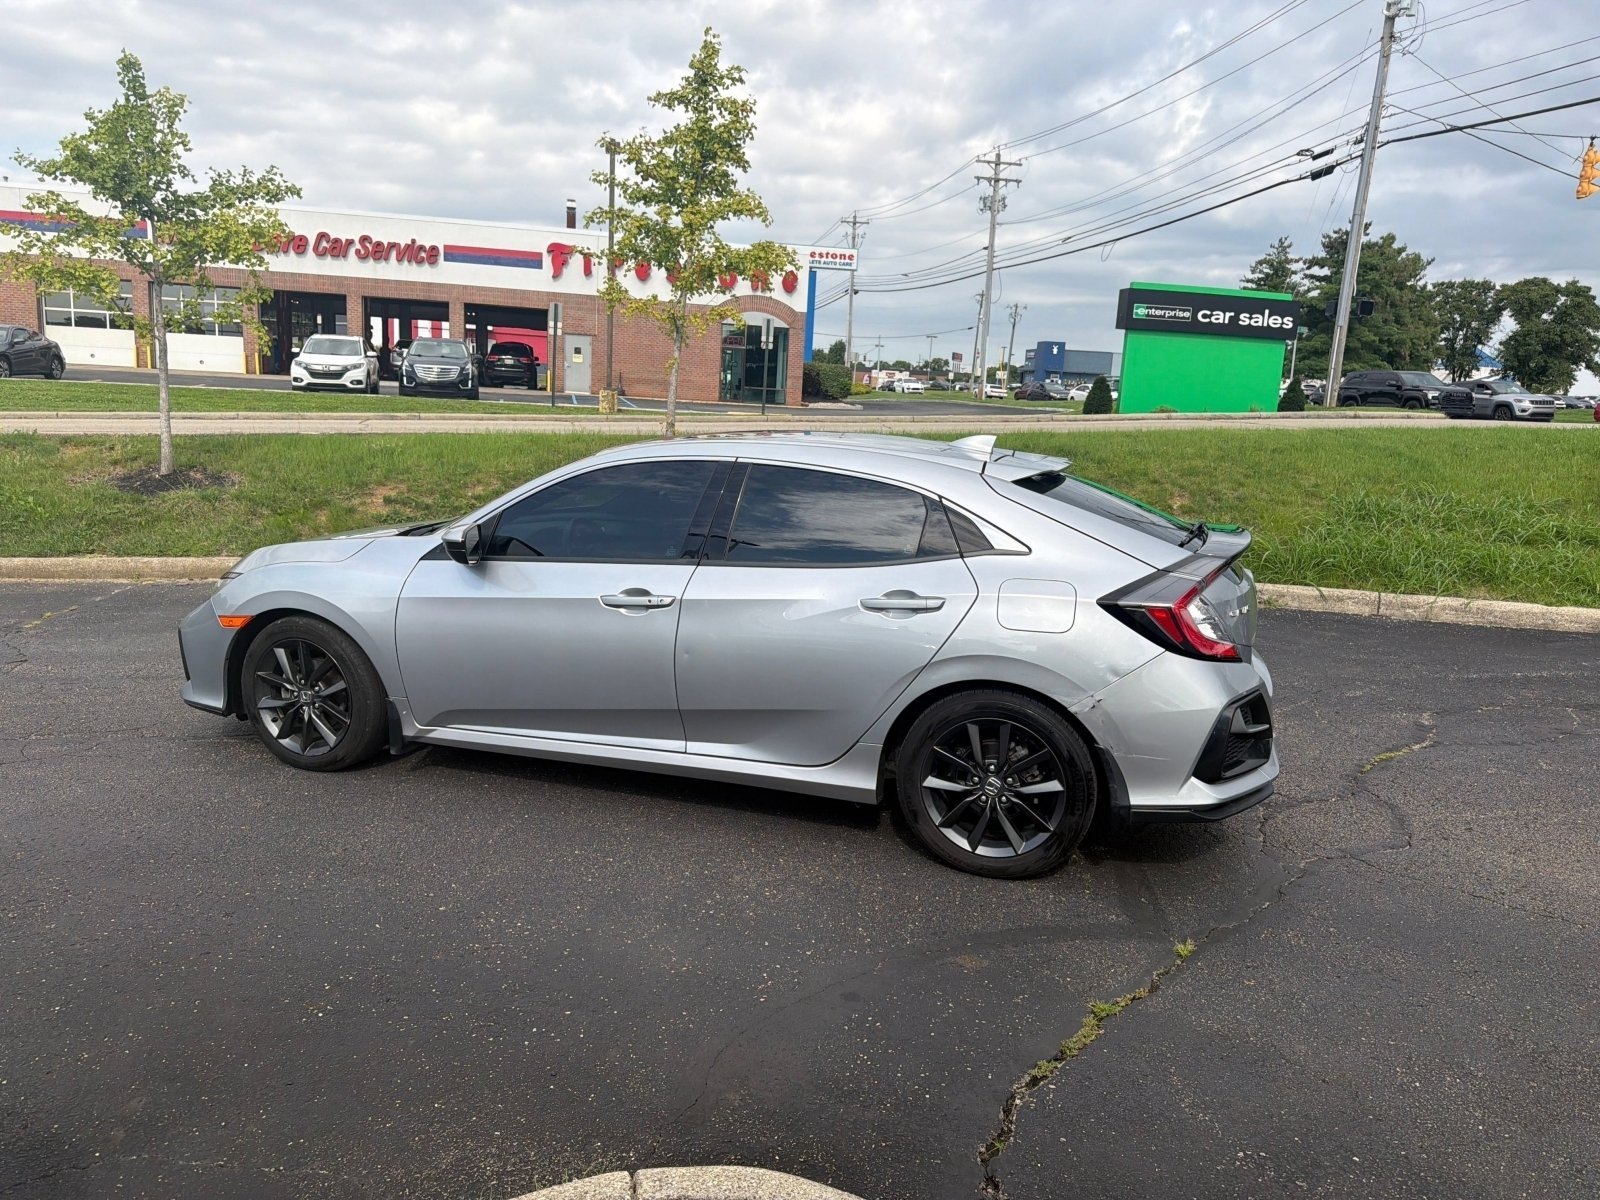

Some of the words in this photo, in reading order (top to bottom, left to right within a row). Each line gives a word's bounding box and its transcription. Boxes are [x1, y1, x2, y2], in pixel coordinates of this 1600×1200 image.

[313, 231, 355, 258] Car
[355, 234, 440, 265] Service
[810, 251, 855, 261] estone
[1136, 306, 1191, 319] enterprise
[1197, 309, 1235, 324] car
[1238, 309, 1294, 329] sales
